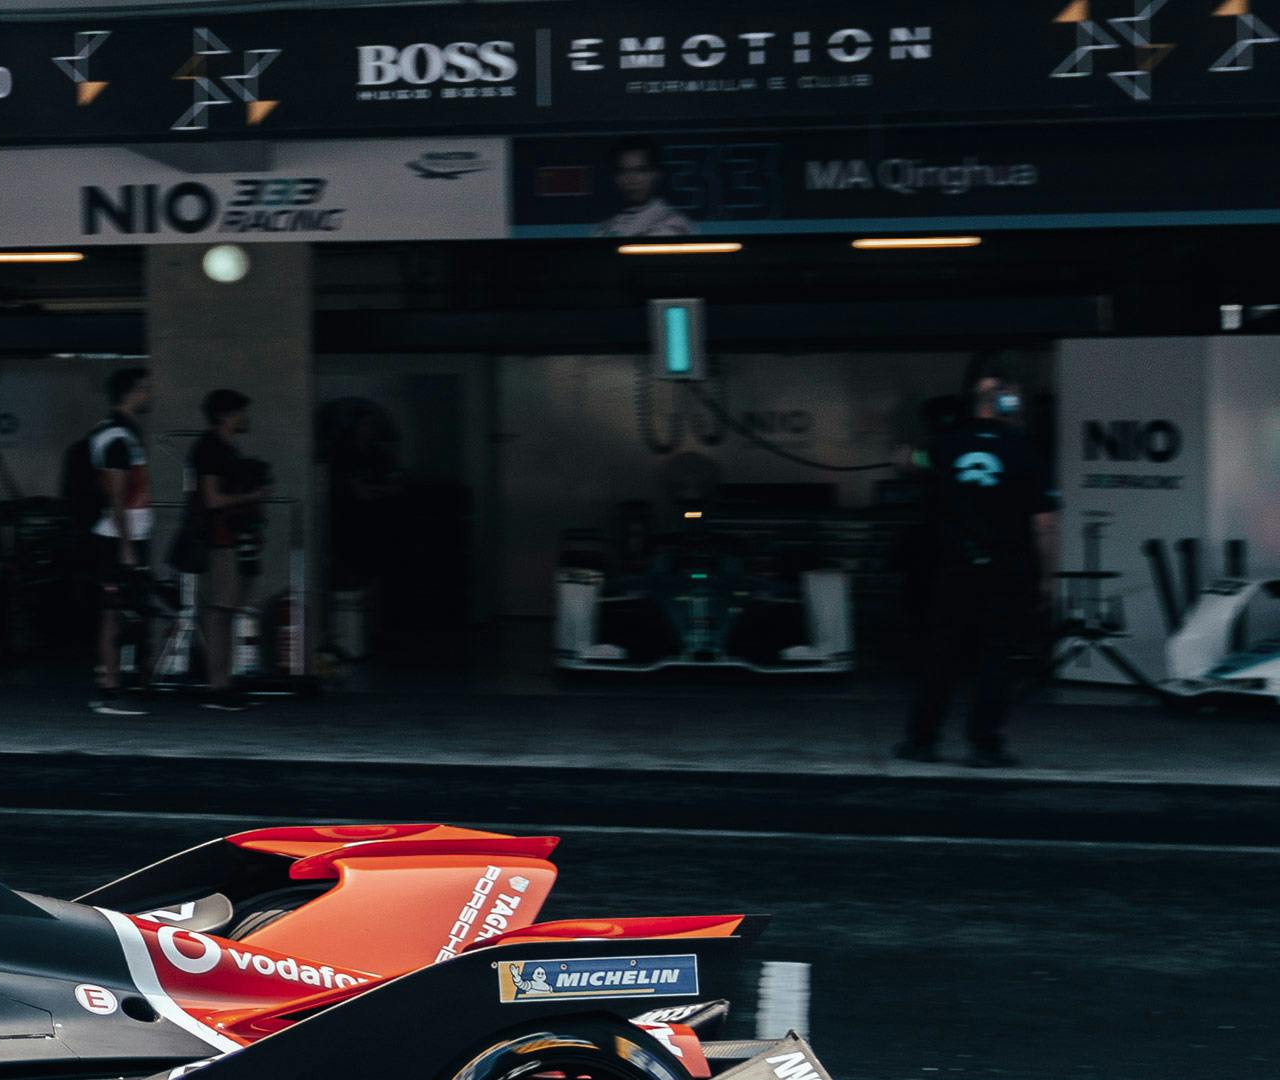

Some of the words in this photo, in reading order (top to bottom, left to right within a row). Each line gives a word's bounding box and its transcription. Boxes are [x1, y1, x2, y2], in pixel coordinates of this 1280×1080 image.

[356, 41, 518, 85] BOSS
[566, 26, 933, 72] EMOTION
[81, 181, 218, 235] NIO
[1083, 419, 1183, 463] NIO
[434, 864, 502, 964] PORSCHE
[473, 892, 522, 943] TAGH
[227, 947, 370, 989] vodafo
[555, 968, 680, 988] MICHELIN
[83, 987, 108, 1010] E
